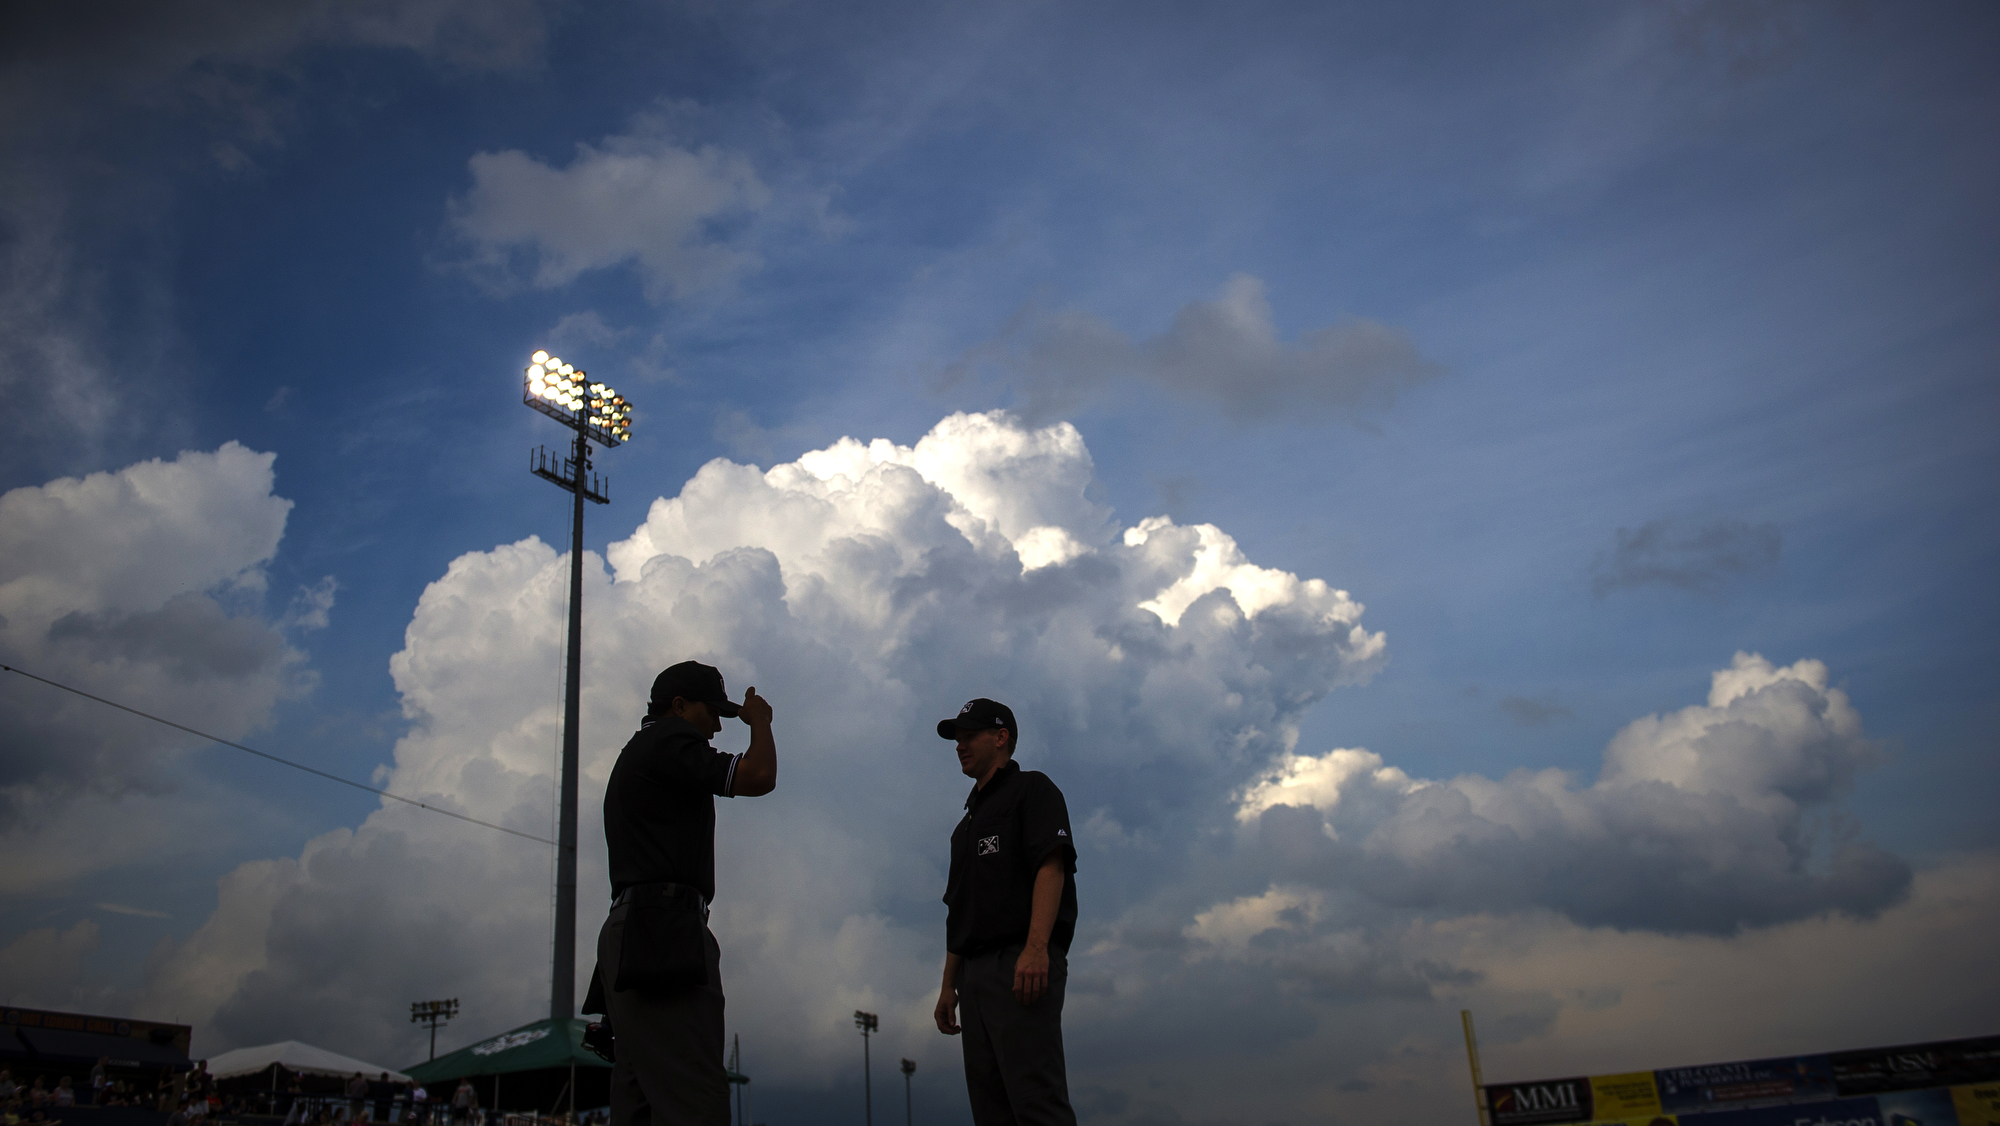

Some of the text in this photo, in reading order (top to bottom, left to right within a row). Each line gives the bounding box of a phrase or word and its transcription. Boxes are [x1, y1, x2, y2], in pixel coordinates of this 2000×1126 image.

[20, 1012, 42, 1026] HOT
[86, 1019, 115, 1034] GRILL
[1512, 1082, 1580, 1112] MMI
